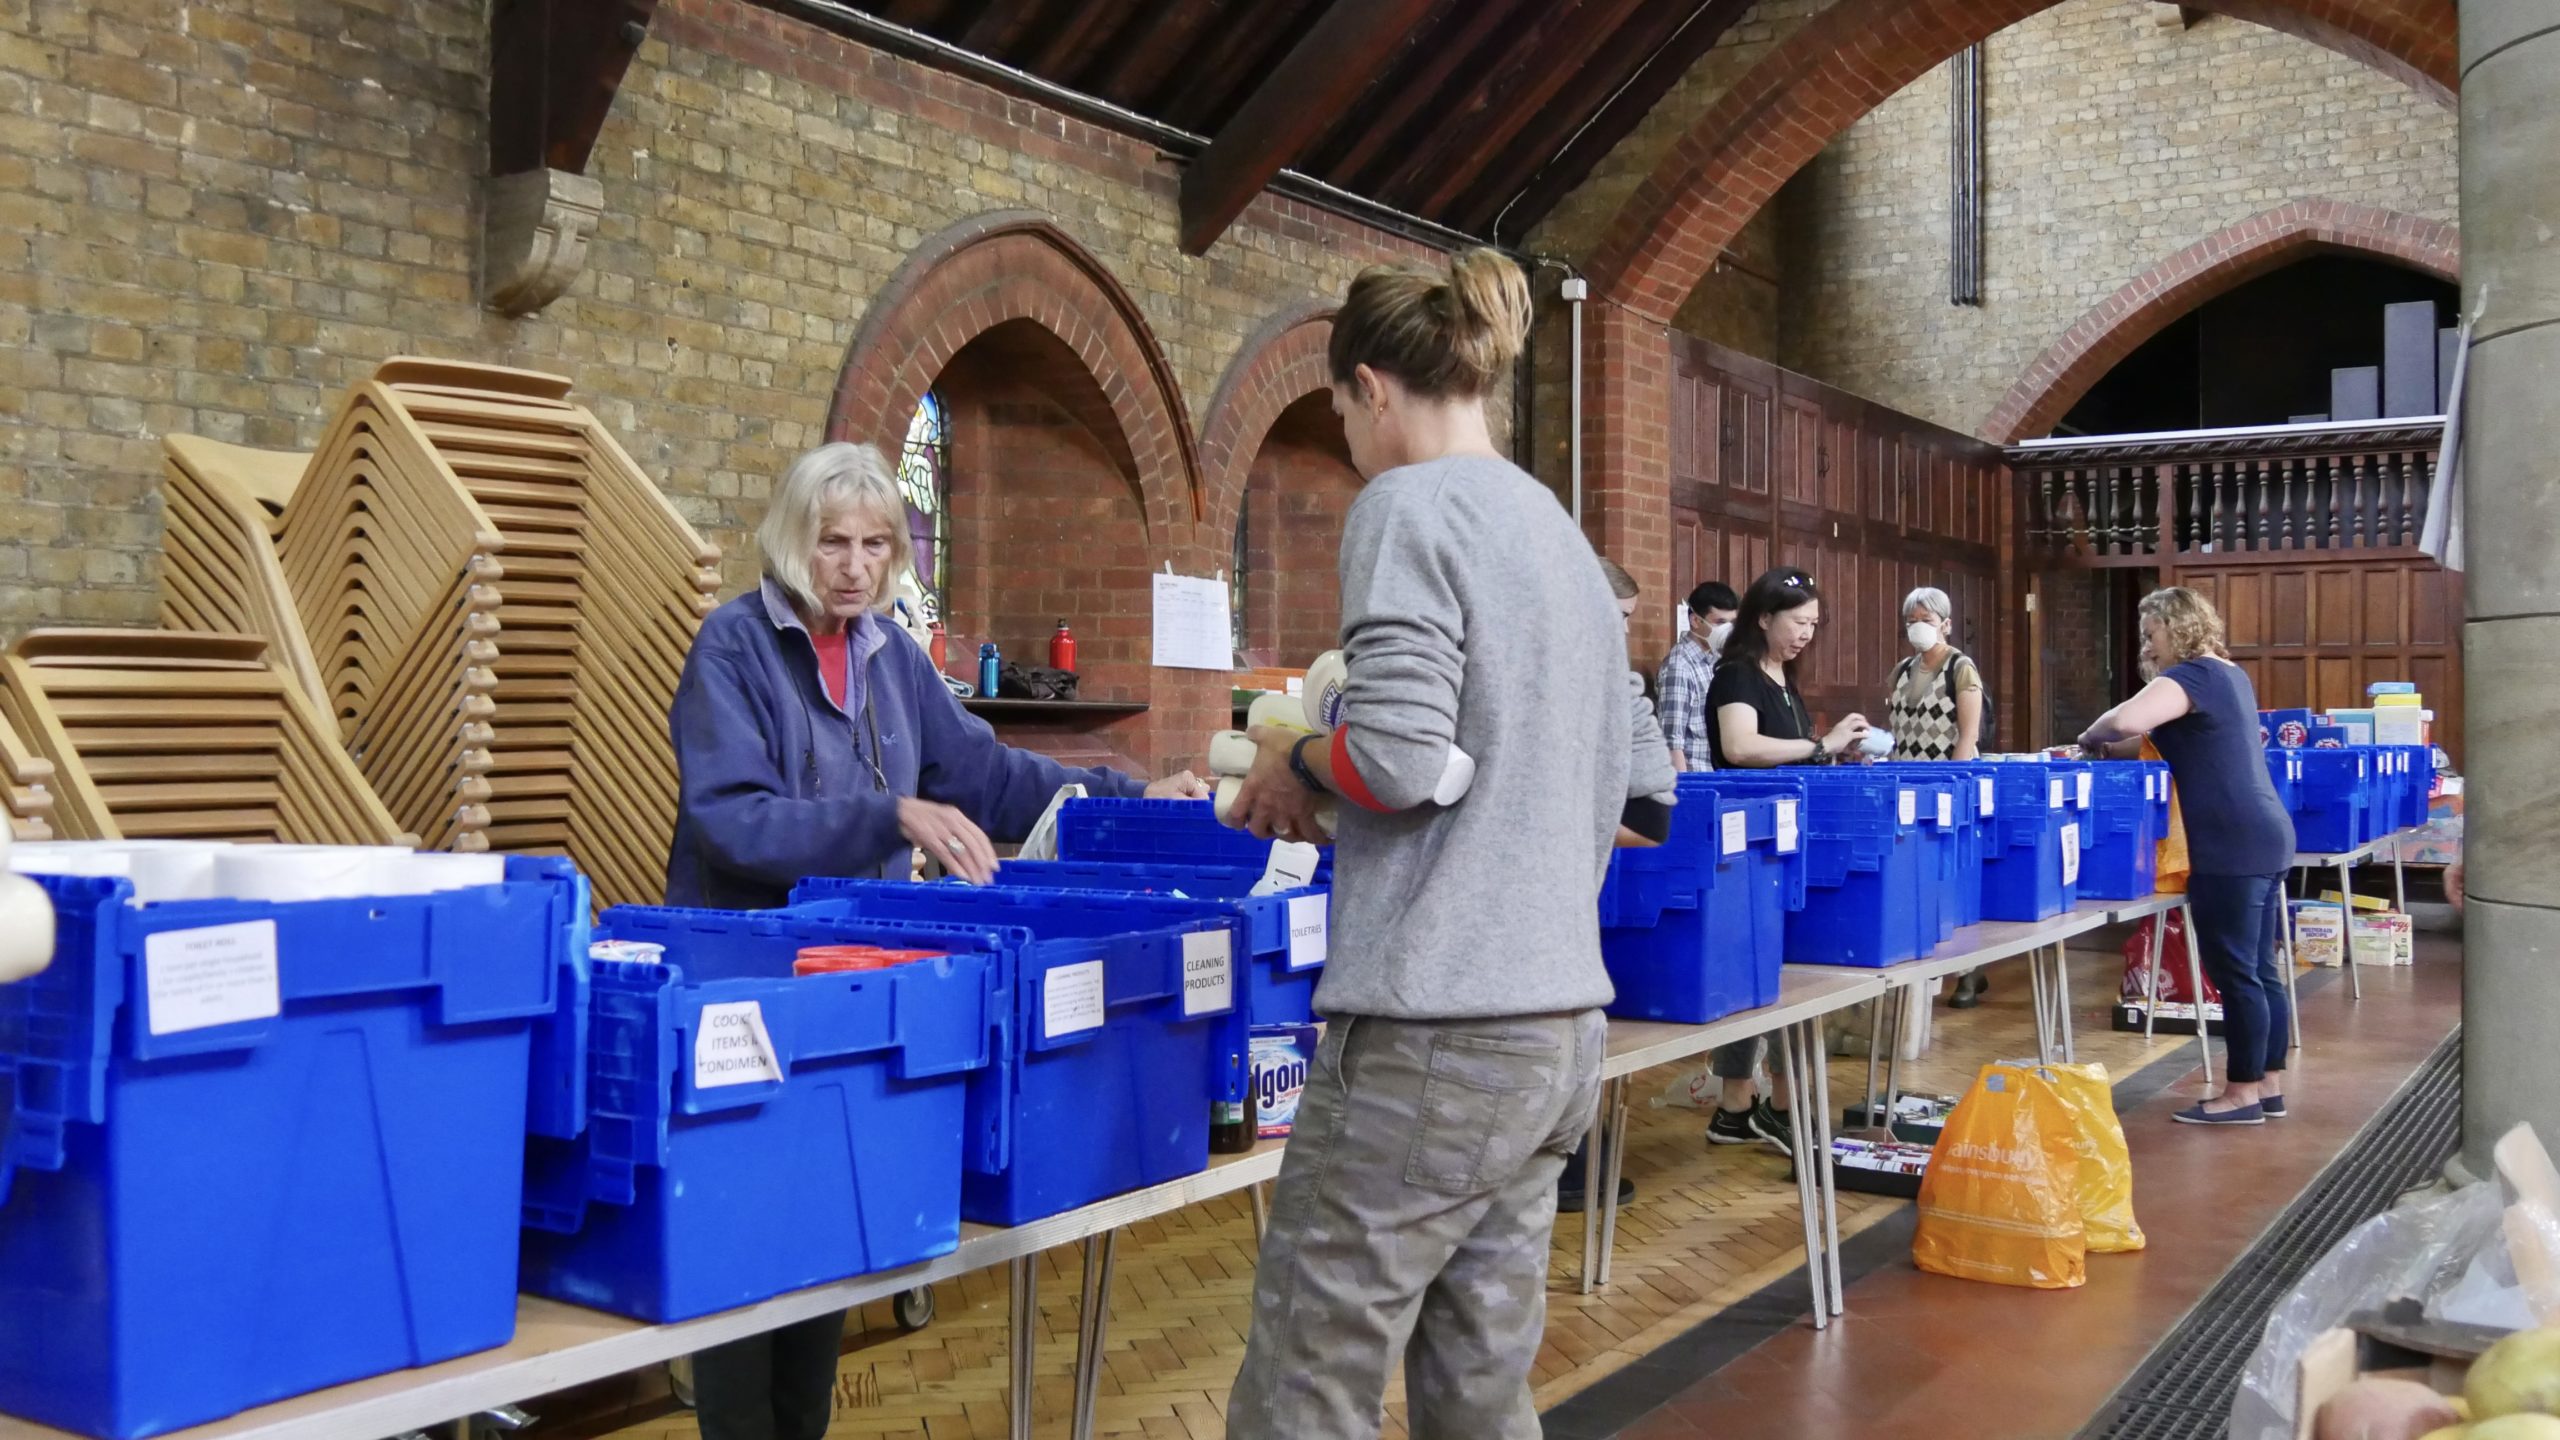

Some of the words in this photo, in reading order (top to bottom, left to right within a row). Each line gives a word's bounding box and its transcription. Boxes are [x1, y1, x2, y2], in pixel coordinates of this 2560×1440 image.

[1322, 687, 1338, 722] HEINZ
[1291, 924, 1322, 938] TOILETRIES
[1186, 956, 1225, 973] CLEANING
[1184, 974, 1225, 992] PRODUCTS
[712, 1013, 752, 1028] COOK
[711, 1034, 748, 1050] ITEMS
[702, 1055, 768, 1074] ONDIMEN
[1254, 1060, 1305, 1109] lgon
